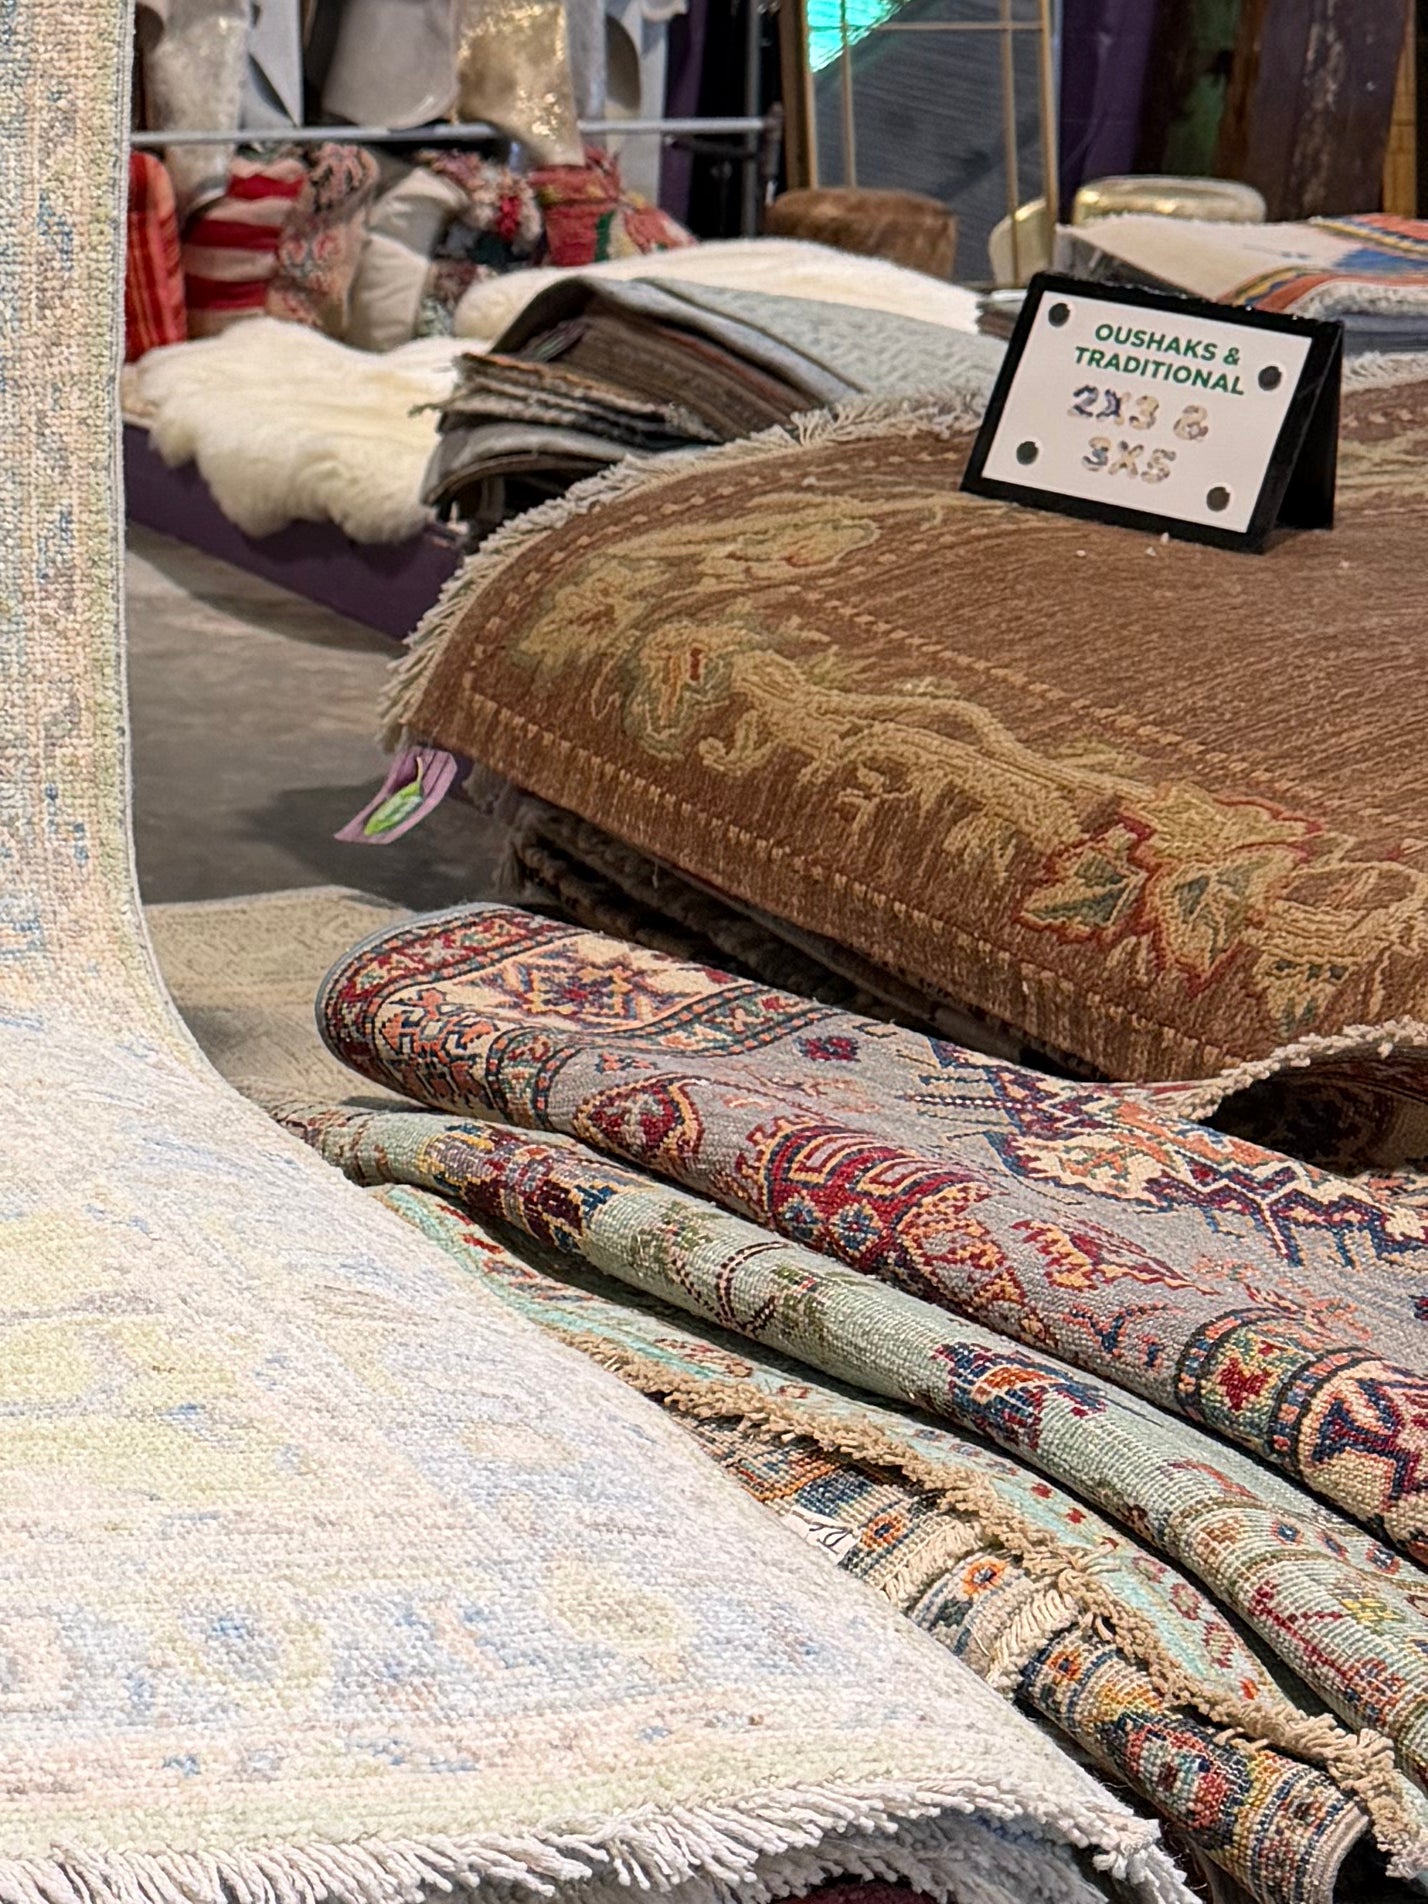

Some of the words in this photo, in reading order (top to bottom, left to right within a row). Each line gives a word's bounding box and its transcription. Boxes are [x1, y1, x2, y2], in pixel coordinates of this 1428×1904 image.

[1095, 323, 1217, 361] OUSHAKS
[1218, 347, 1240, 366] &
[1074, 346, 1244, 395] TRADITIONAL
[1081, 436, 1177, 484] 3X5
